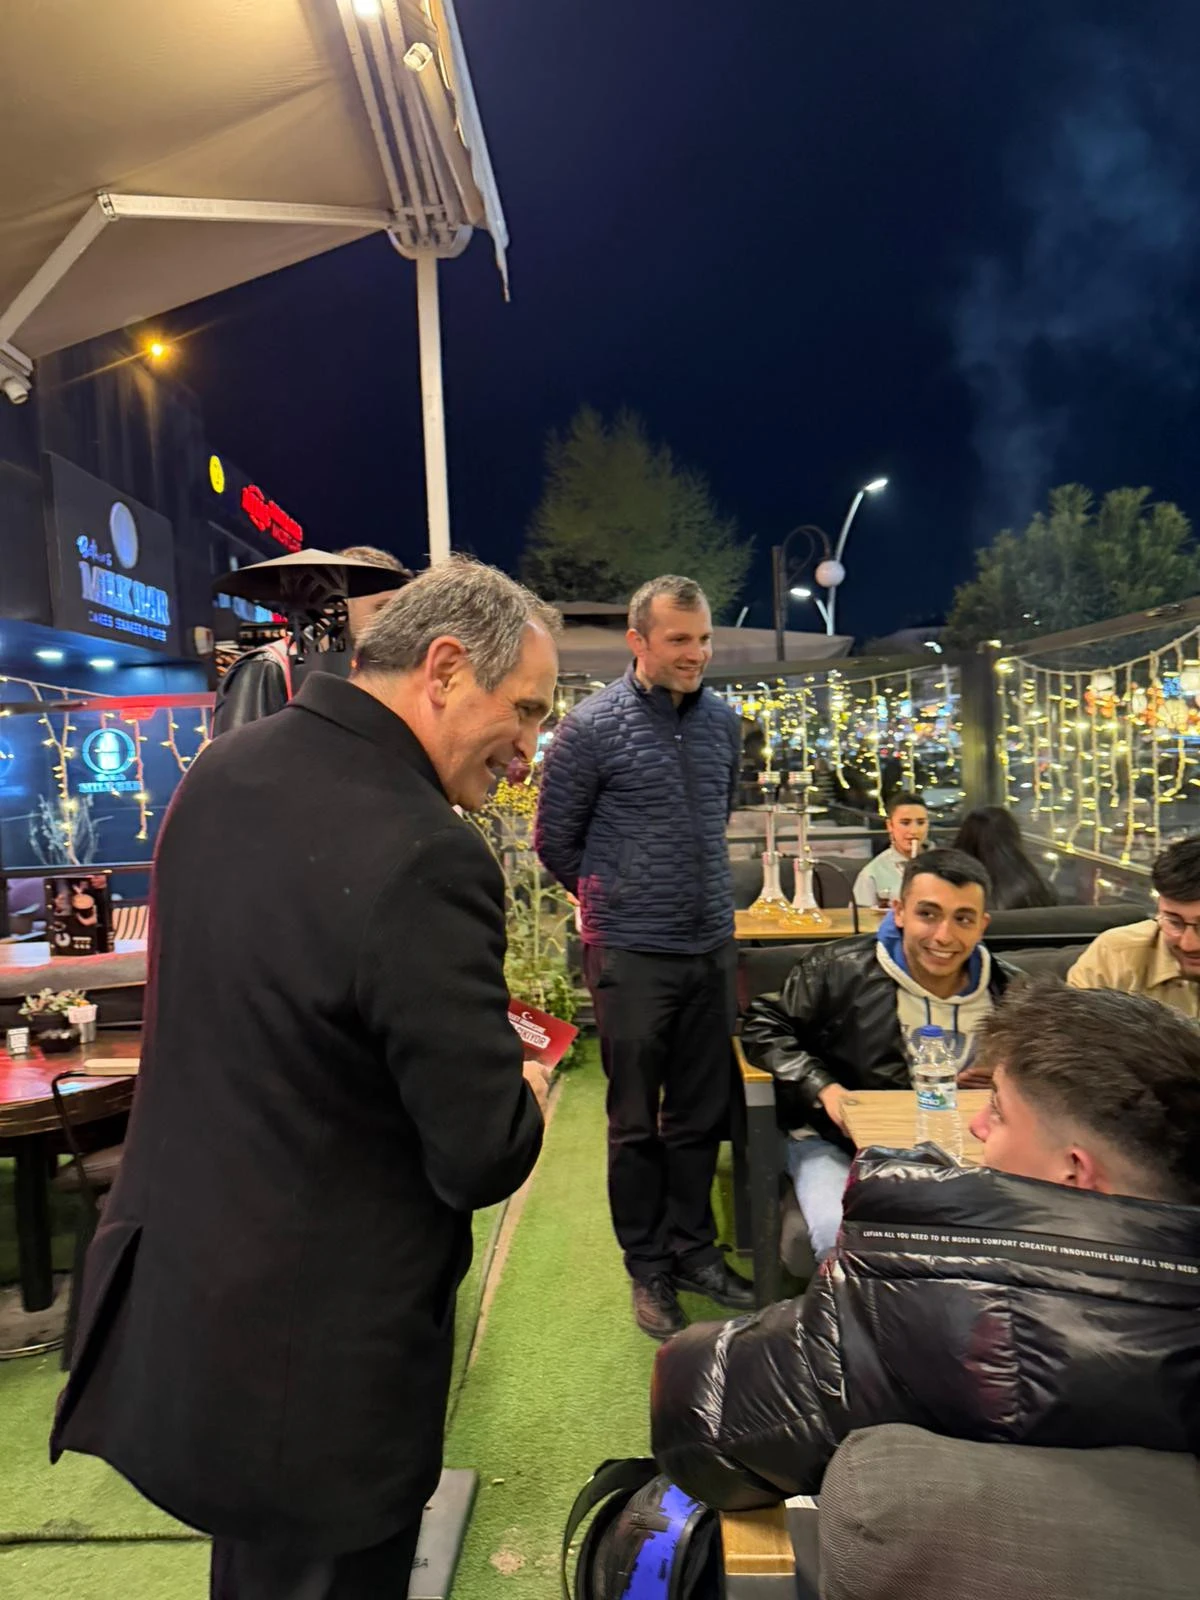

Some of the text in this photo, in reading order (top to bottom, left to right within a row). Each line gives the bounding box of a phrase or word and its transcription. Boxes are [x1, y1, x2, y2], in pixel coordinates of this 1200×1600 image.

[884, 1231, 896, 1239] ALL
[897, 1232, 909, 1240] YOU
[911, 1233, 929, 1241] NEED
[951, 1236, 981, 1244] MODERN
[982, 1238, 1017, 1248] COMFORT
[1019, 1241, 1057, 1254] CREATIVE
[1060, 1246, 1108, 1260] INNOVATIVE
[1109, 1253, 1140, 1265] LUFIAN
[1141, 1258, 1157, 1268] ALL
[1158, 1260, 1175, 1271] YOU
[1177, 1263, 1198, 1274] NEED
